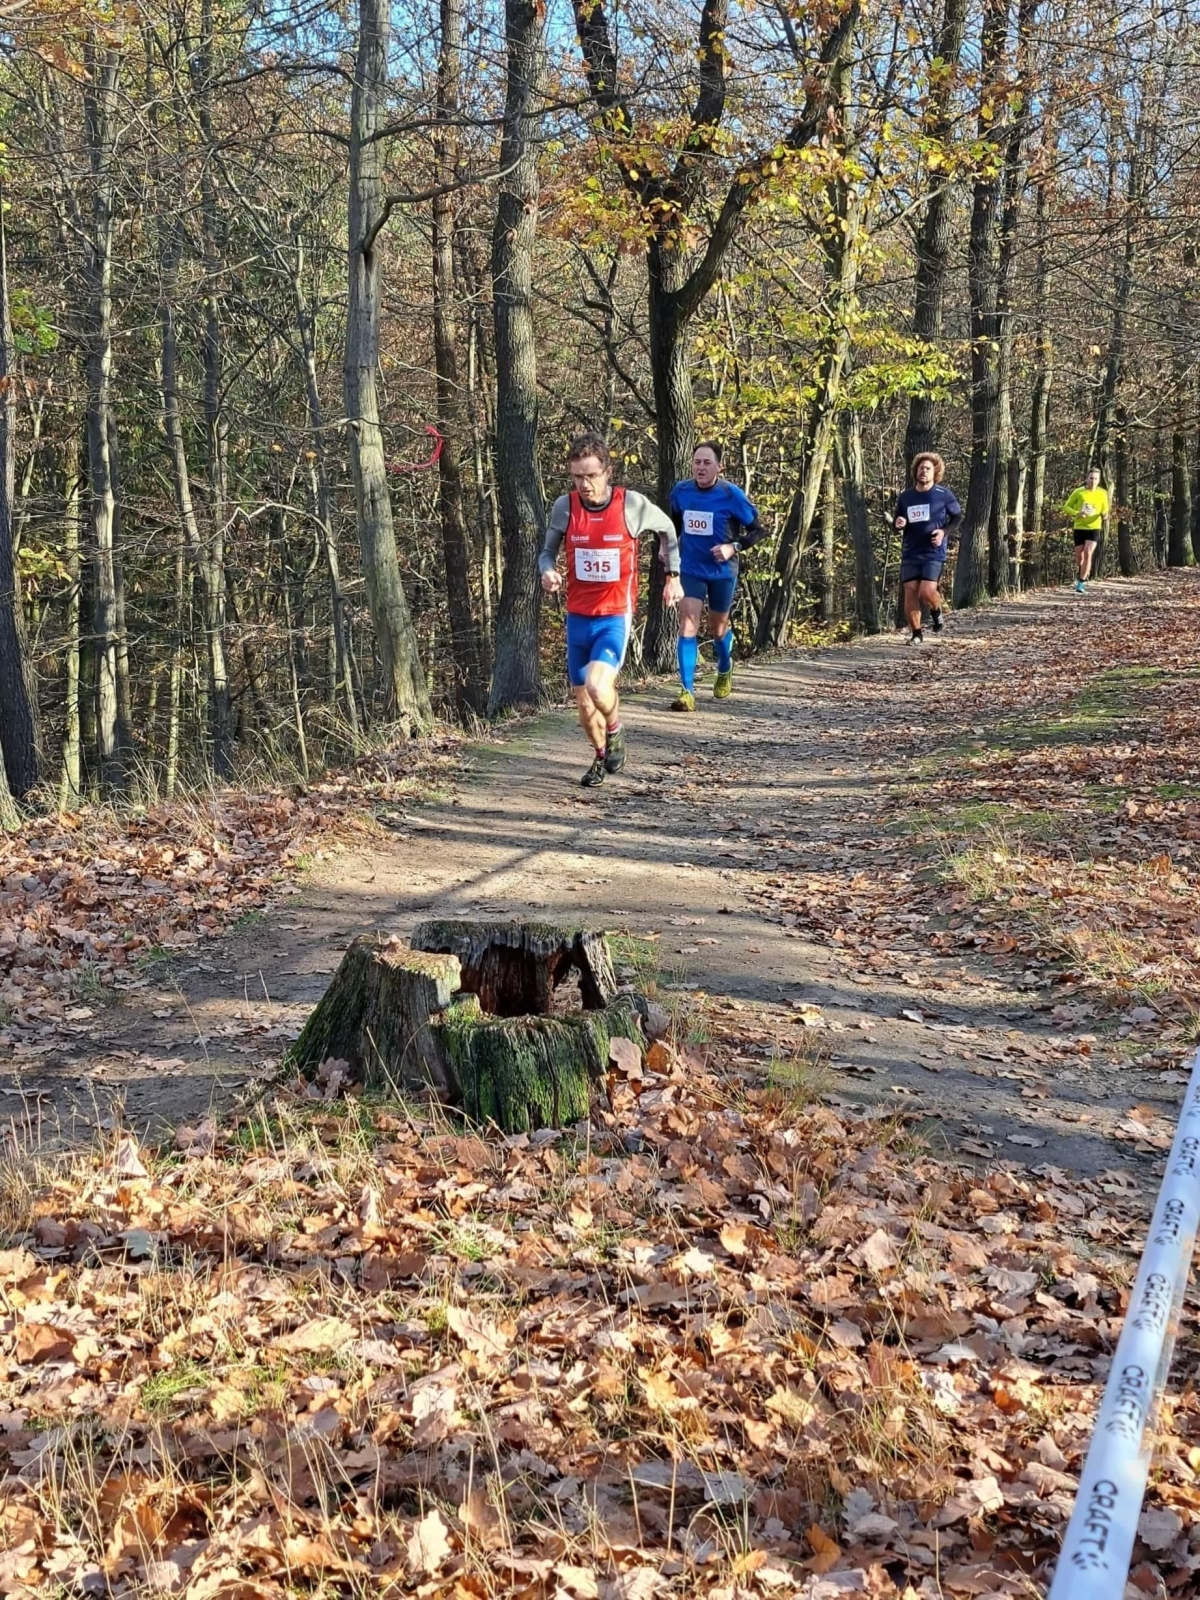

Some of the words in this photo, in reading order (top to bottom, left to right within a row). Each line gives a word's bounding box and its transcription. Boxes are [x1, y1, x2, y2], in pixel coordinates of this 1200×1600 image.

[688, 519, 707, 529] 300
[584, 561, 610, 572] 315
[1160, 1199, 1185, 1236] CRAFT
[1139, 1273, 1170, 1322] CRAFT
[1113, 1365, 1146, 1426] CRAFT
[1080, 1480, 1118, 1553] CRAFT
